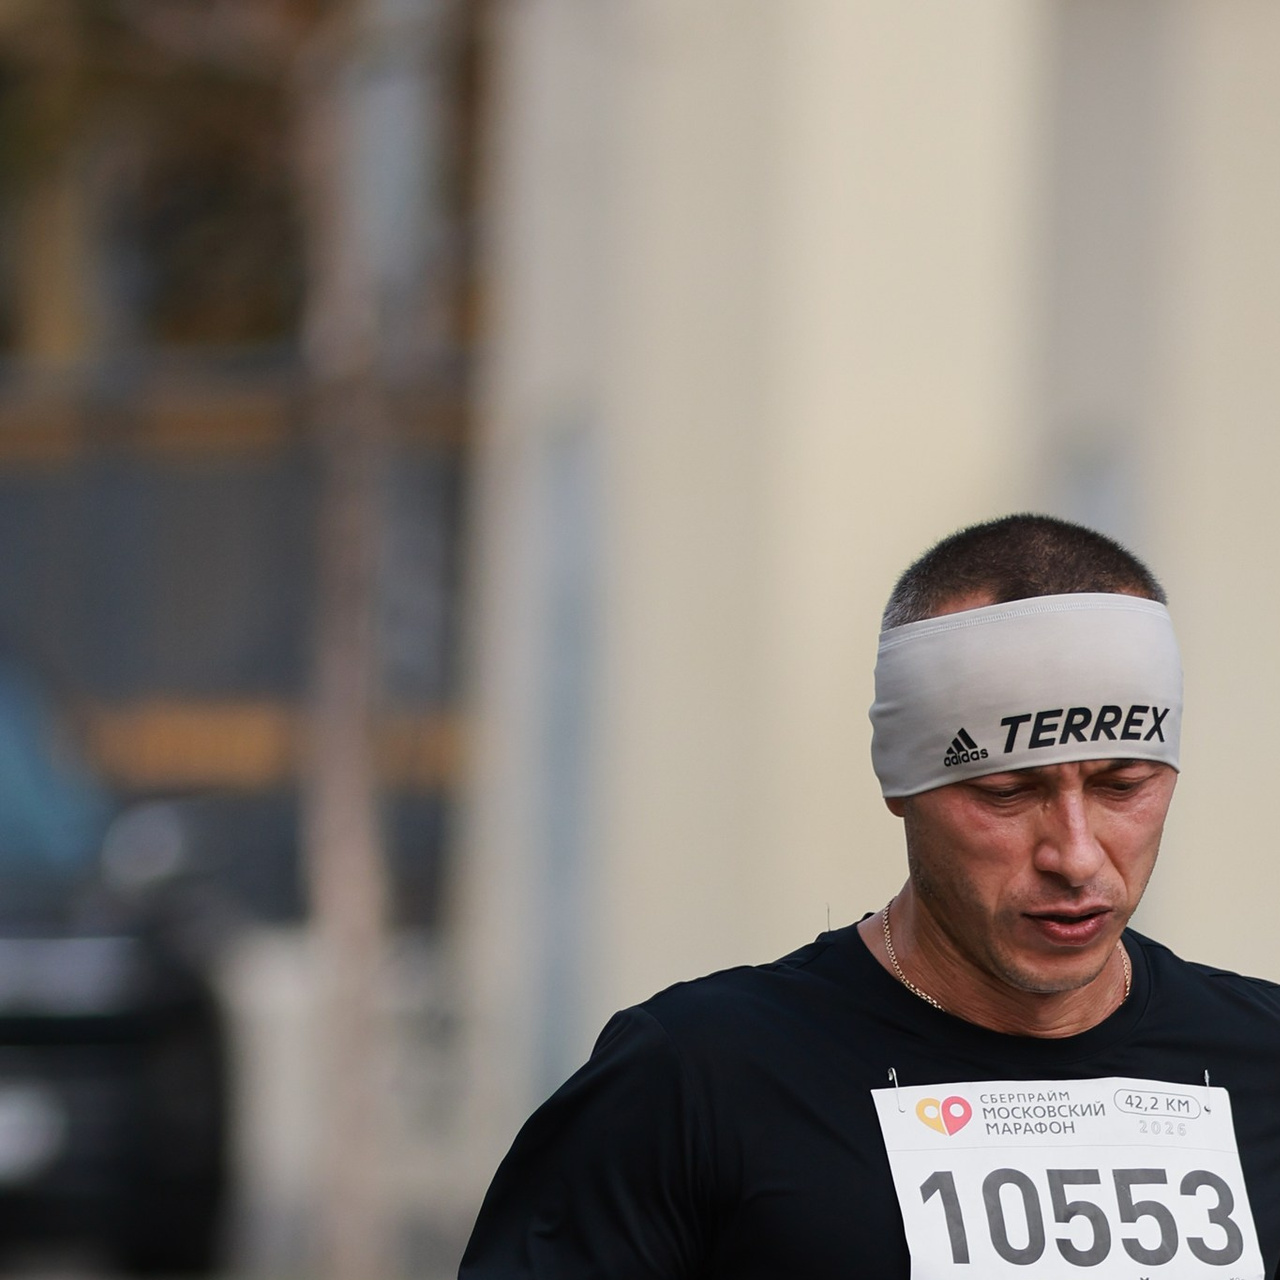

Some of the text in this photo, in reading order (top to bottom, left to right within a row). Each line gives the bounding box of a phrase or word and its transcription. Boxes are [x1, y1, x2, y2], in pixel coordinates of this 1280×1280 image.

[1000, 705, 1170, 753] TERREX
[944, 748, 989, 767] adidas
[980, 1091, 1070, 1104] СБЕРПРАЙМ
[1125, 1094, 1190, 1113] 42,2 КМ
[982, 1101, 1106, 1120] МОСКОВСКИЙ
[986, 1121, 1076, 1135] МАРАФОН
[1139, 1120, 1187, 1136] 2026
[919, 1167, 1244, 1268] 10553
